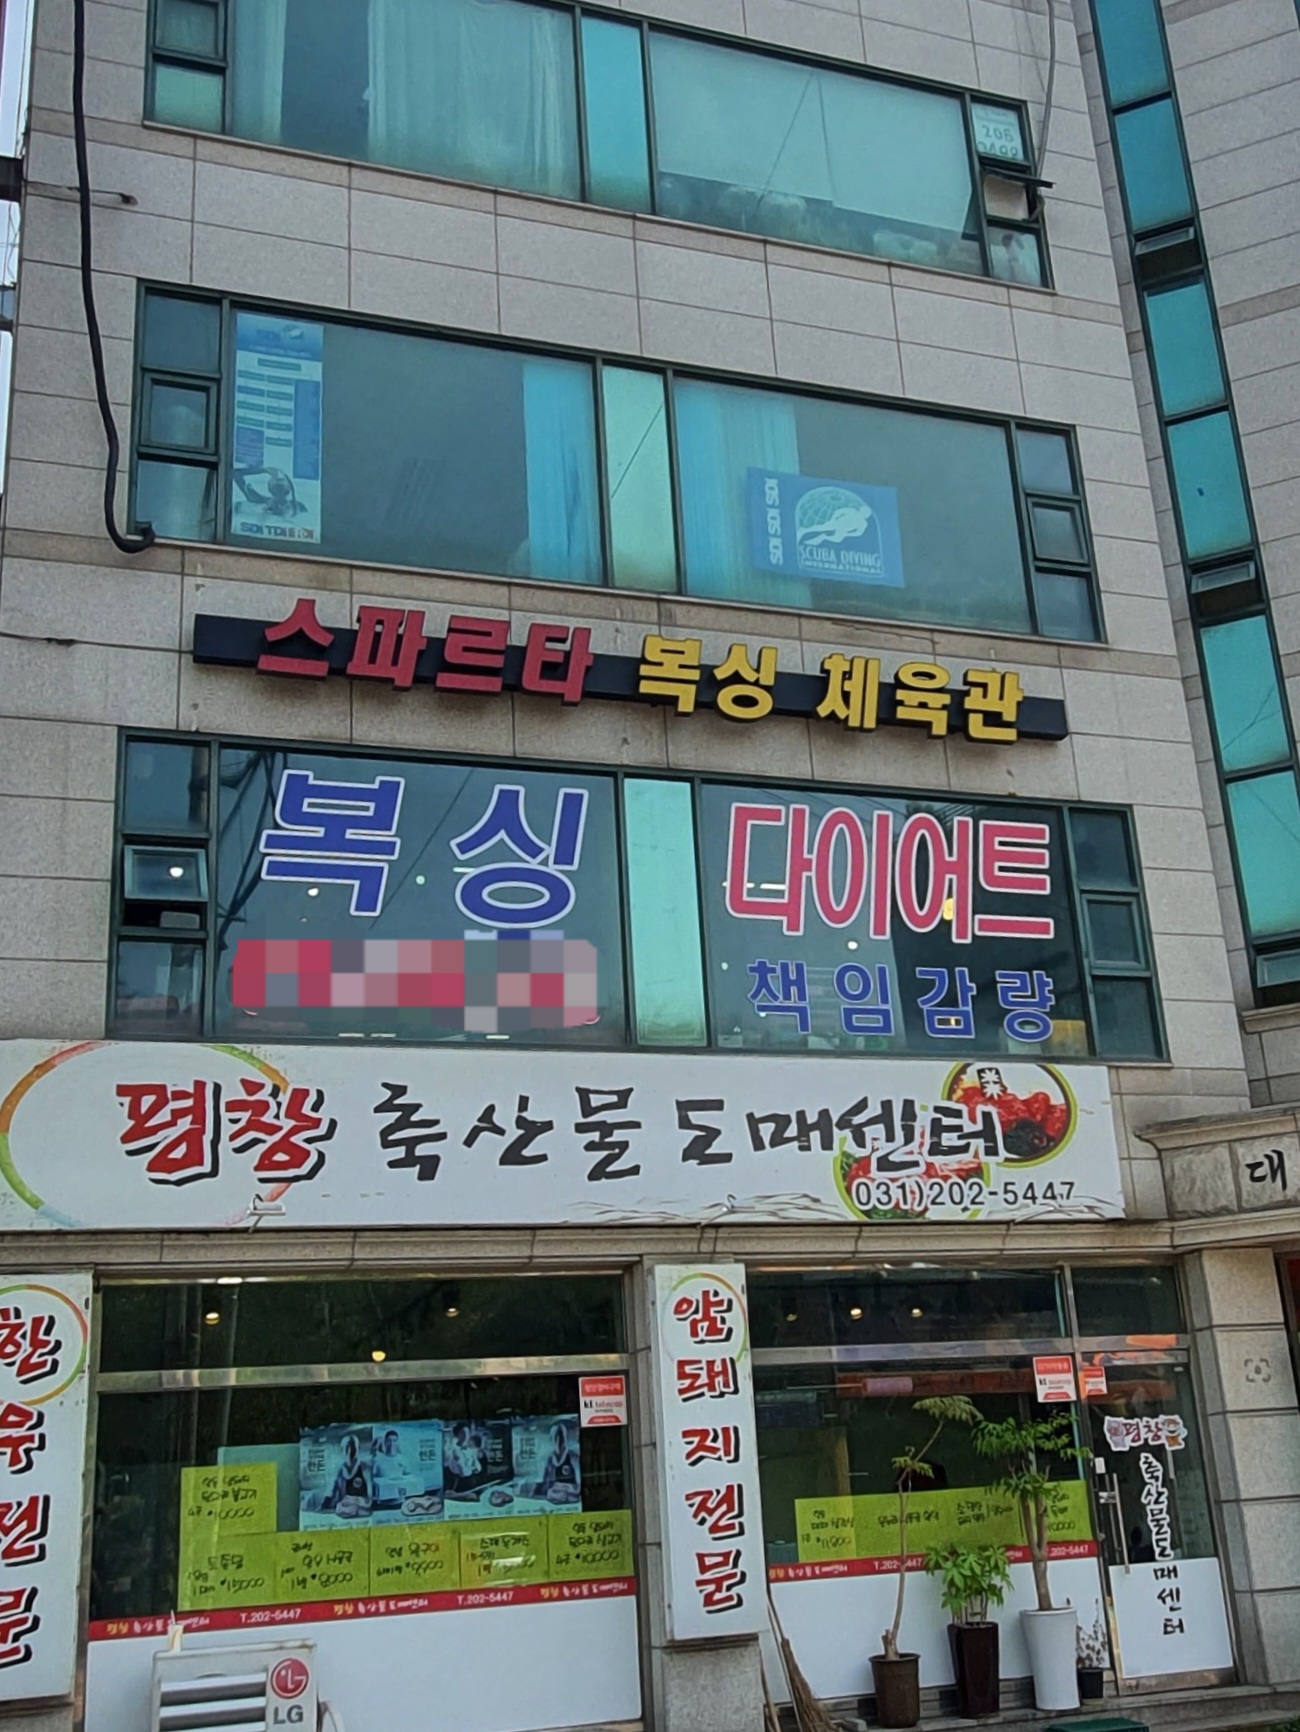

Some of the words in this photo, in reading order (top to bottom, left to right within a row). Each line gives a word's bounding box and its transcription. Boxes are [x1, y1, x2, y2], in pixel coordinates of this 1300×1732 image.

[800, 545, 837, 561] SCUBA
[840, 550, 881, 567] DIVING
[801, 560, 881, 573] INTERNATIONAL
[257, 598, 594, 704] 스파르타
[638, 634, 778, 719] 복싱
[816, 652, 1025, 743] 체육관
[259, 769, 589, 928] 복싱
[725, 802, 1054, 943] 다이어트
[115, 1078, 338, 1187] 평창
[373, 1081, 642, 1182] 축산물
[675, 1095, 1008, 1174] 도매센터
[1245, 1149, 1288, 1192] 대
[853, 1180, 1075, 1209] 031)202-5447
[1122, 1419, 1162, 1443] 평창
[273, 1704, 304, 1725] LG
